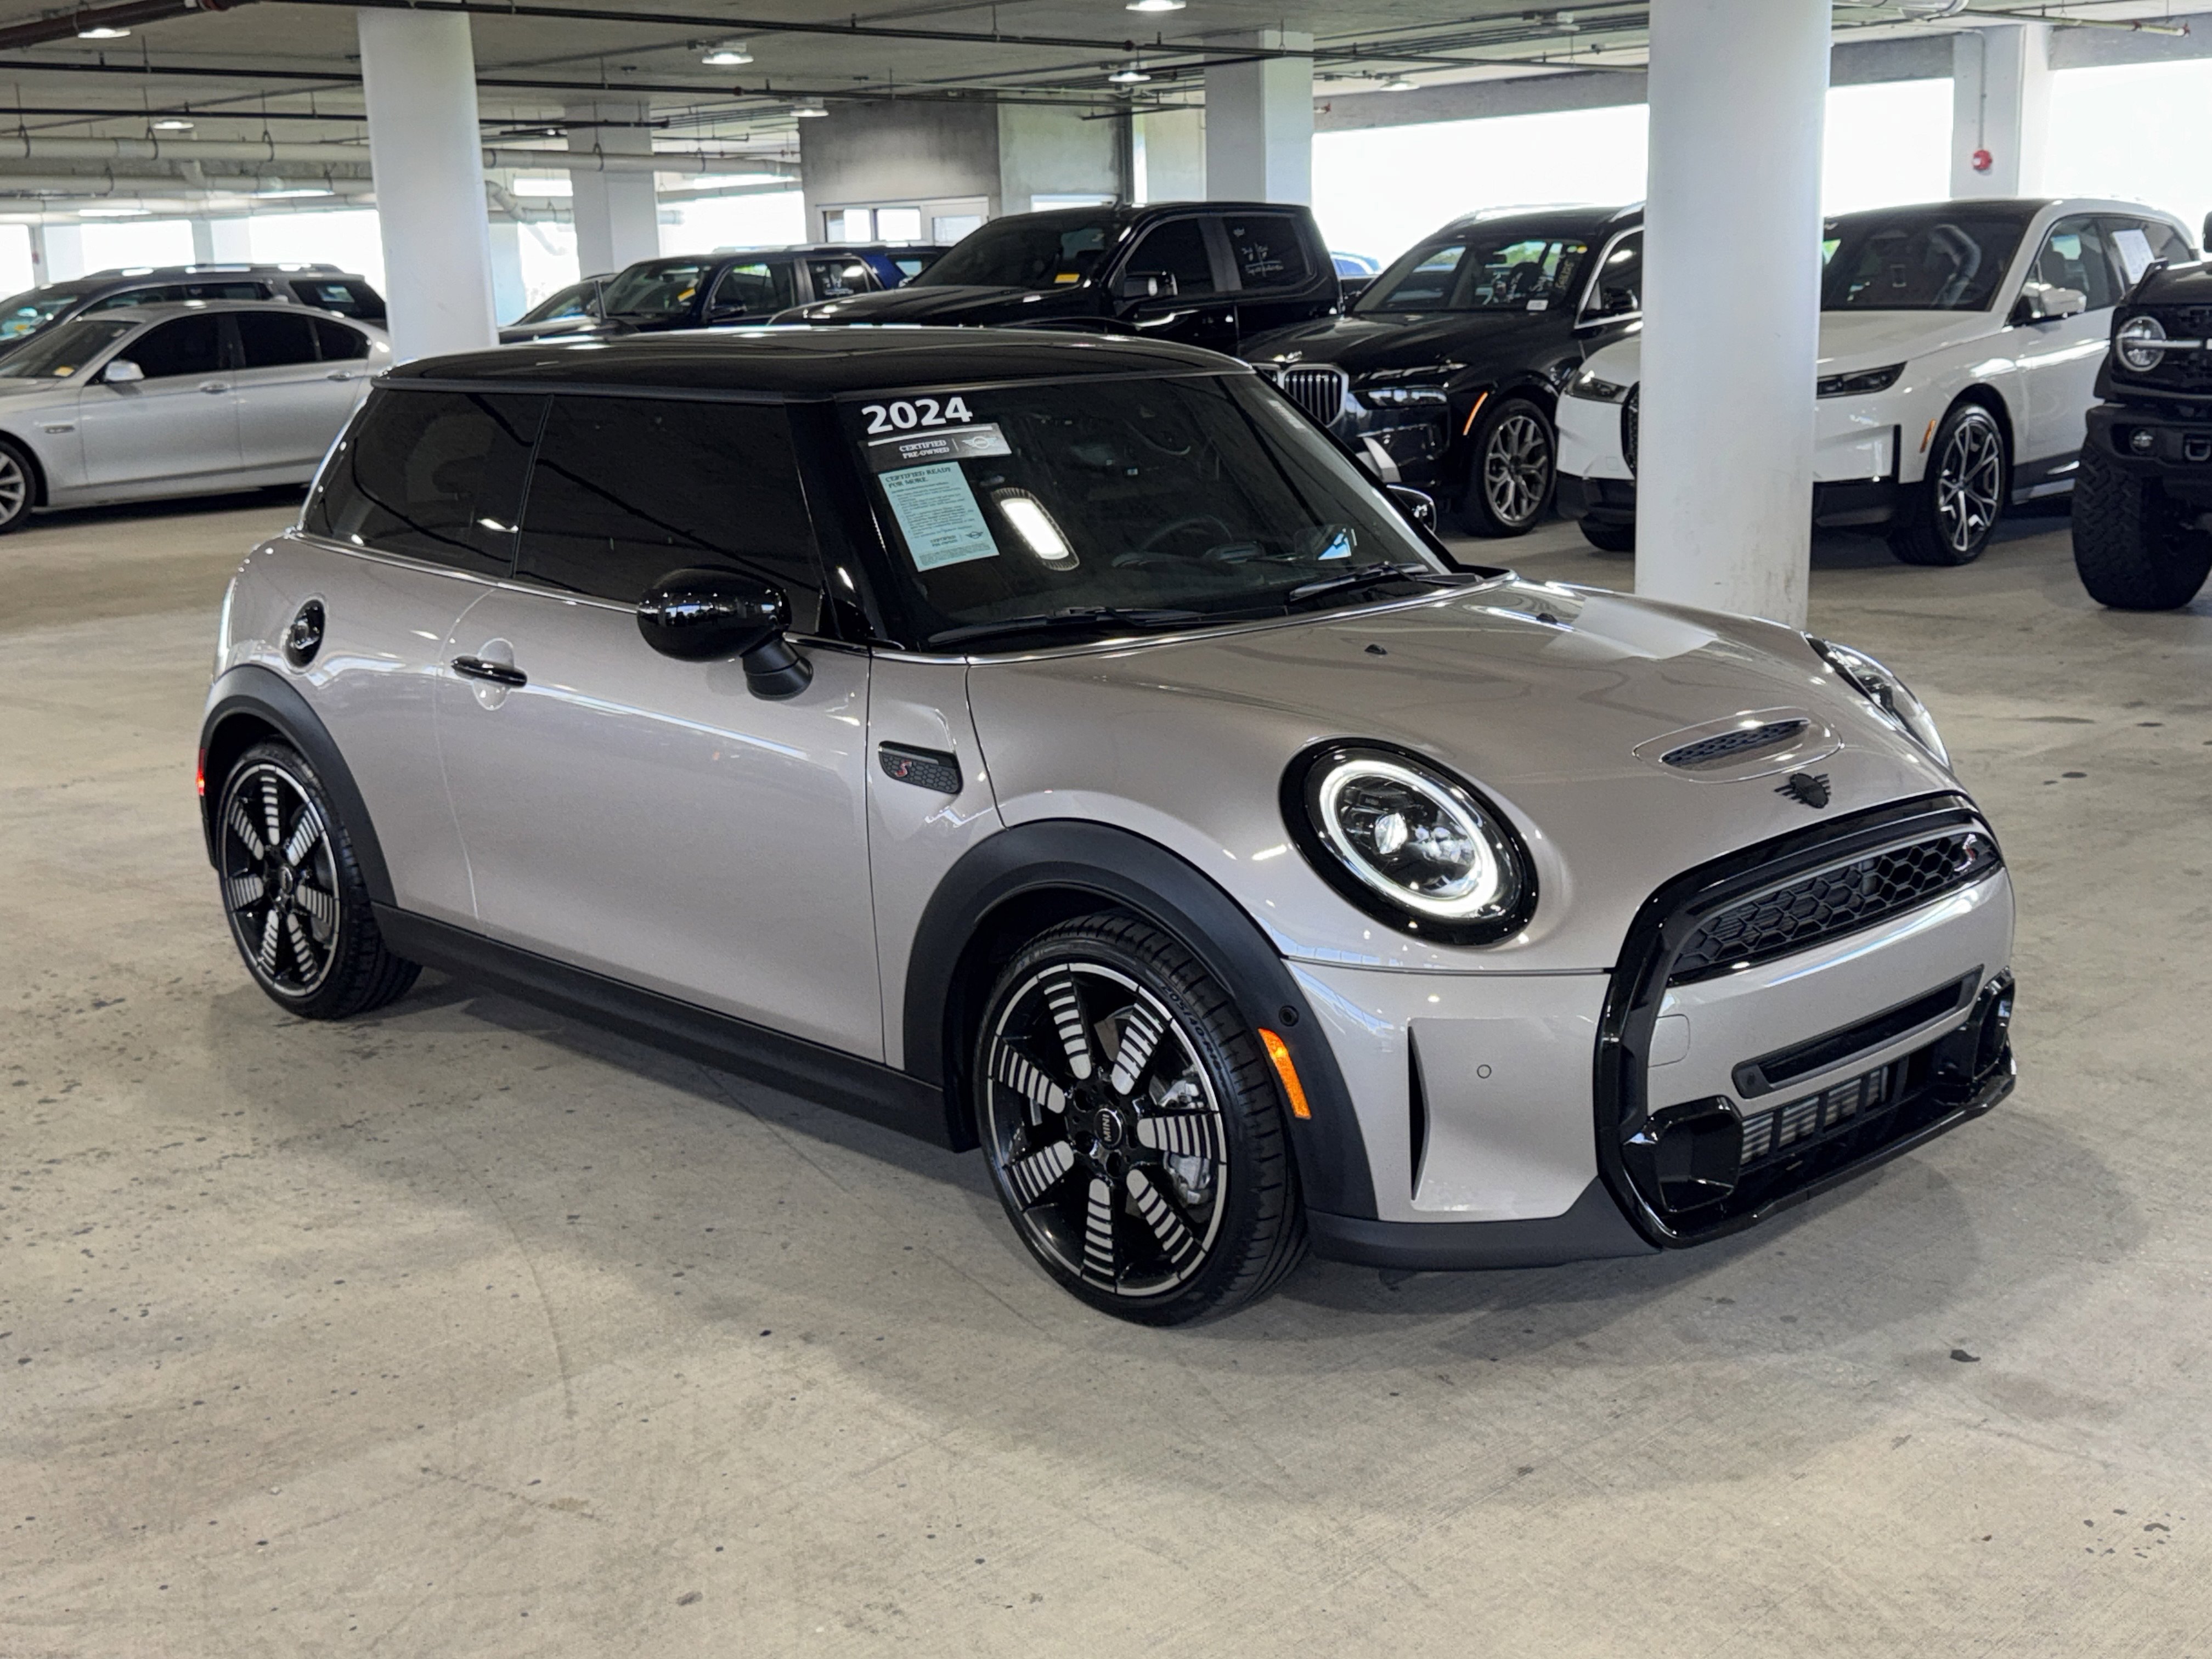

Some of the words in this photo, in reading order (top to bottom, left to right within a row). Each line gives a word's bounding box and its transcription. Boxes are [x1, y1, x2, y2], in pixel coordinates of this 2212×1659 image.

[861, 397, 973, 434] 2024
[899, 440, 947, 452] CERTIFIED
[885, 470, 925, 482] CERTIFIED
[1102, 1114, 1112, 1142] MINI
